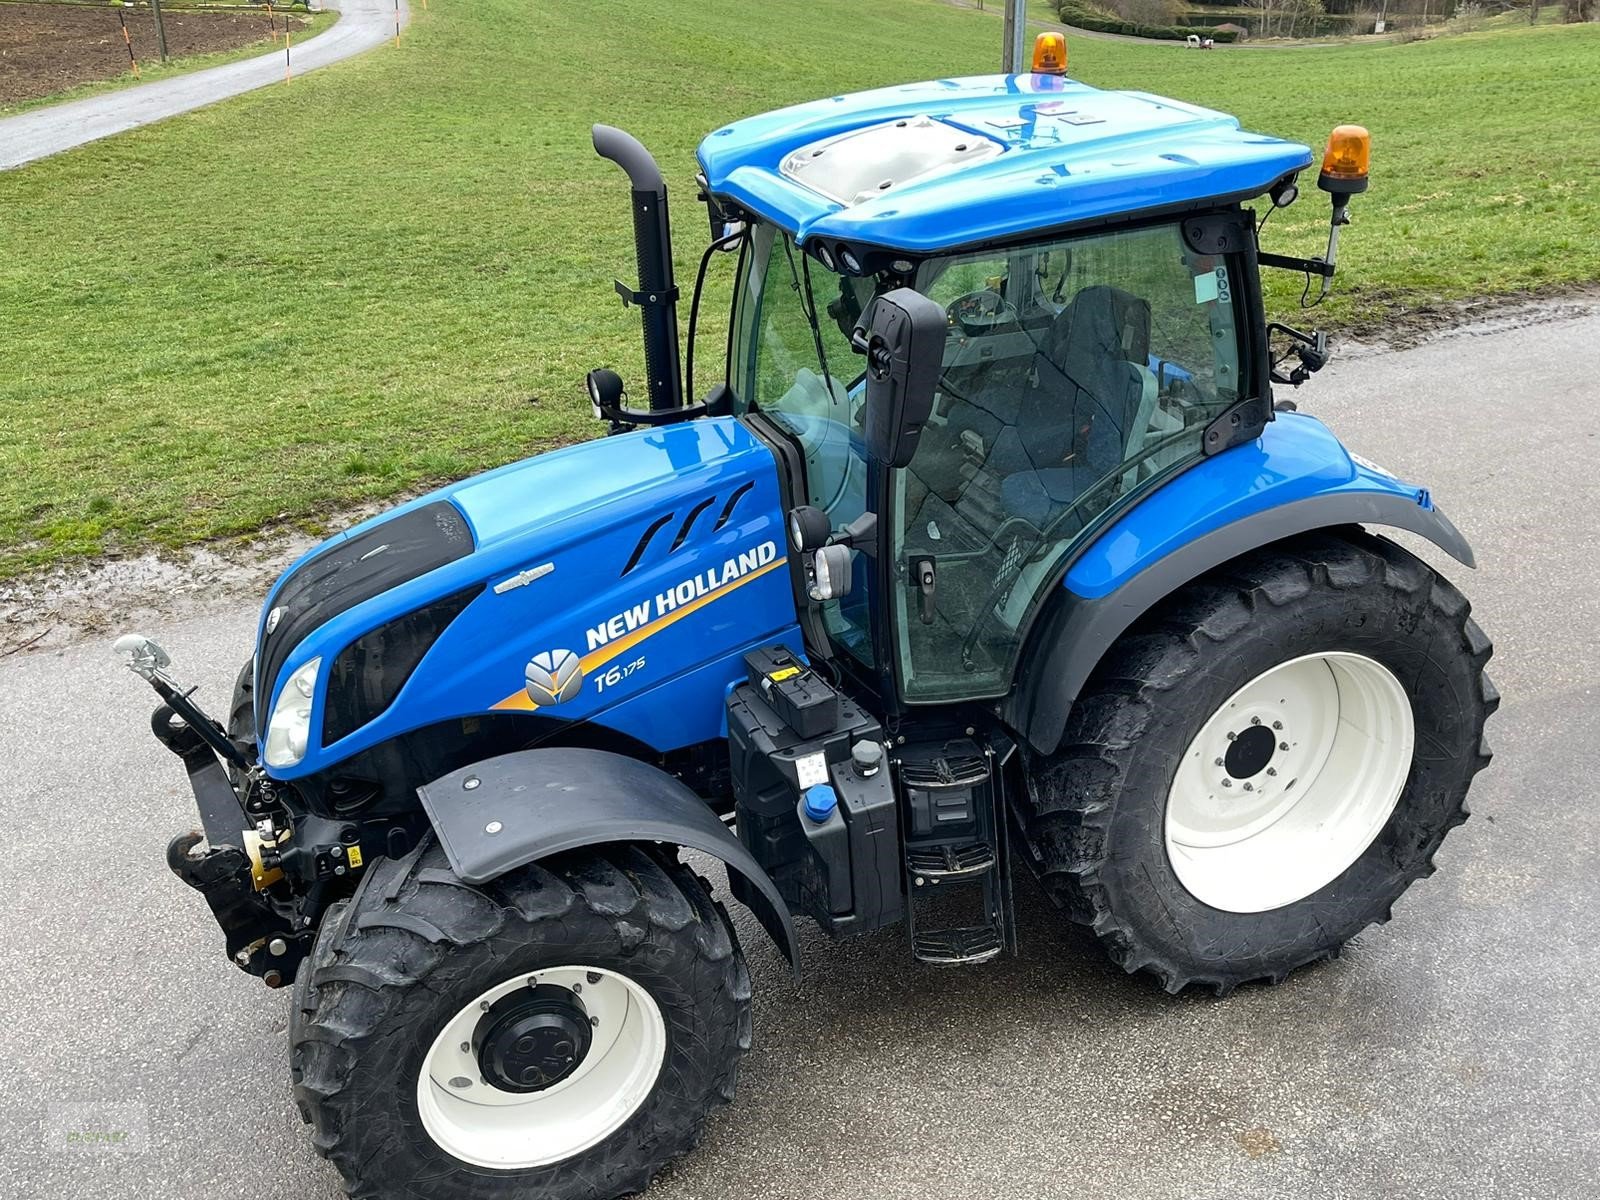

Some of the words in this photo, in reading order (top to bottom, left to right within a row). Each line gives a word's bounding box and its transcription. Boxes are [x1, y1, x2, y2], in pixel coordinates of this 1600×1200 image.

[586, 600, 651, 651] NEW
[656, 541, 776, 616] HOLLAND
[594, 656, 646, 693] T6.175
